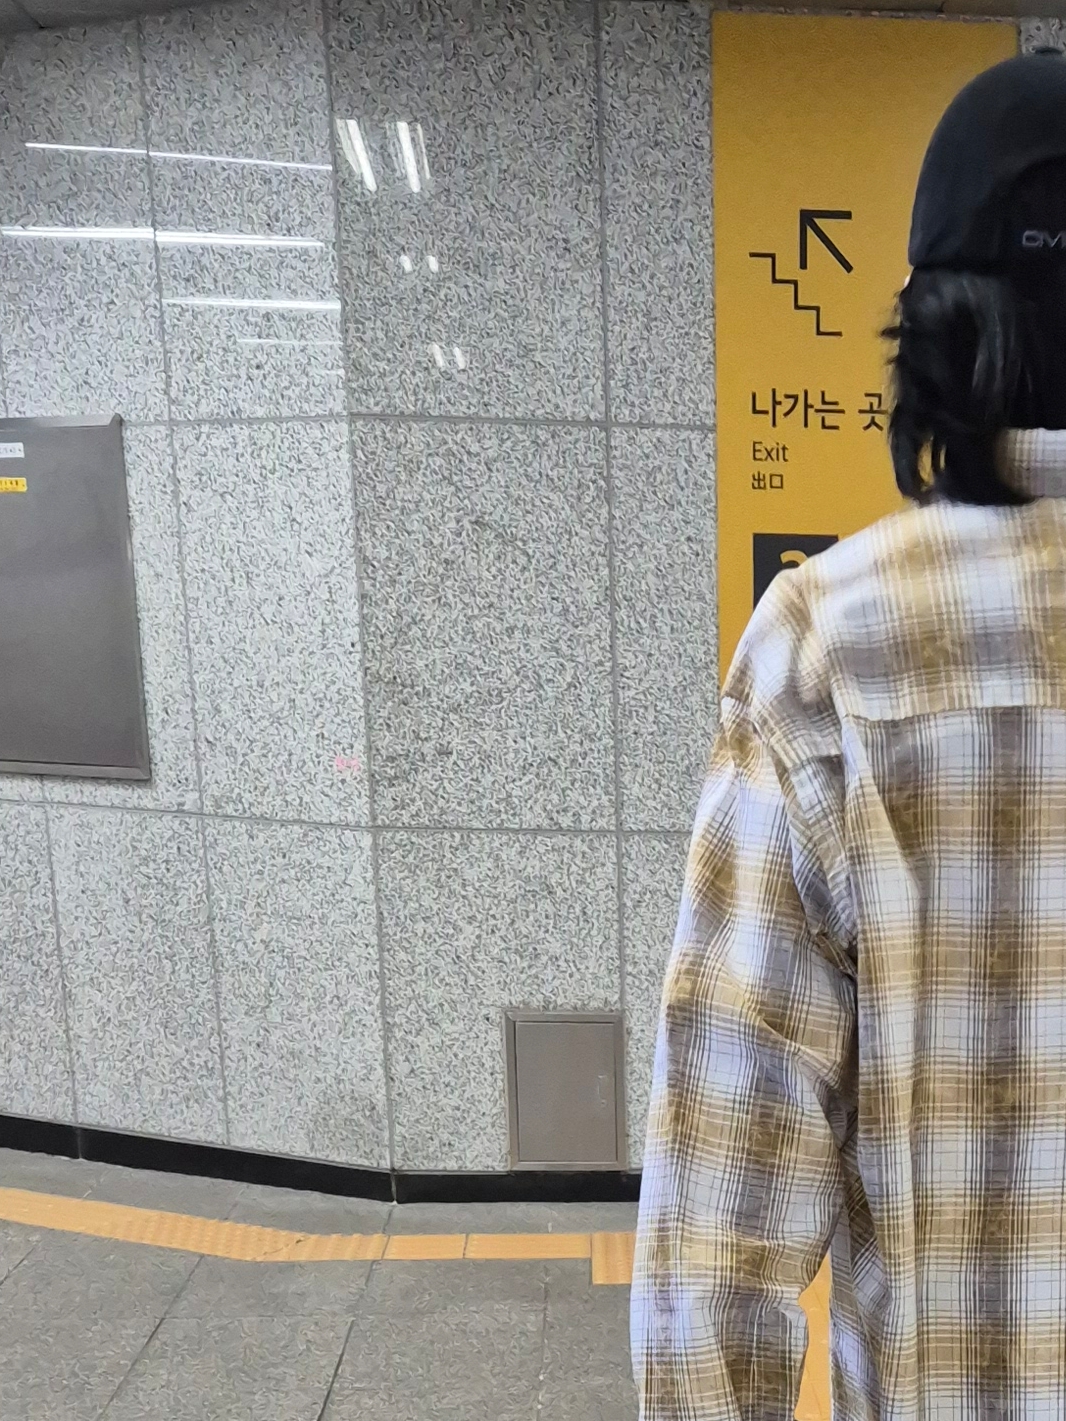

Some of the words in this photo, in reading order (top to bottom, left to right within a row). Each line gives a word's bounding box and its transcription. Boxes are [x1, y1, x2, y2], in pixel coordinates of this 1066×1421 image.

[752, 388, 845, 430] 나가는
[858, 392, 888, 431] 곳
[752, 441, 789, 462] Exit
[752, 471, 784, 490] 出口
